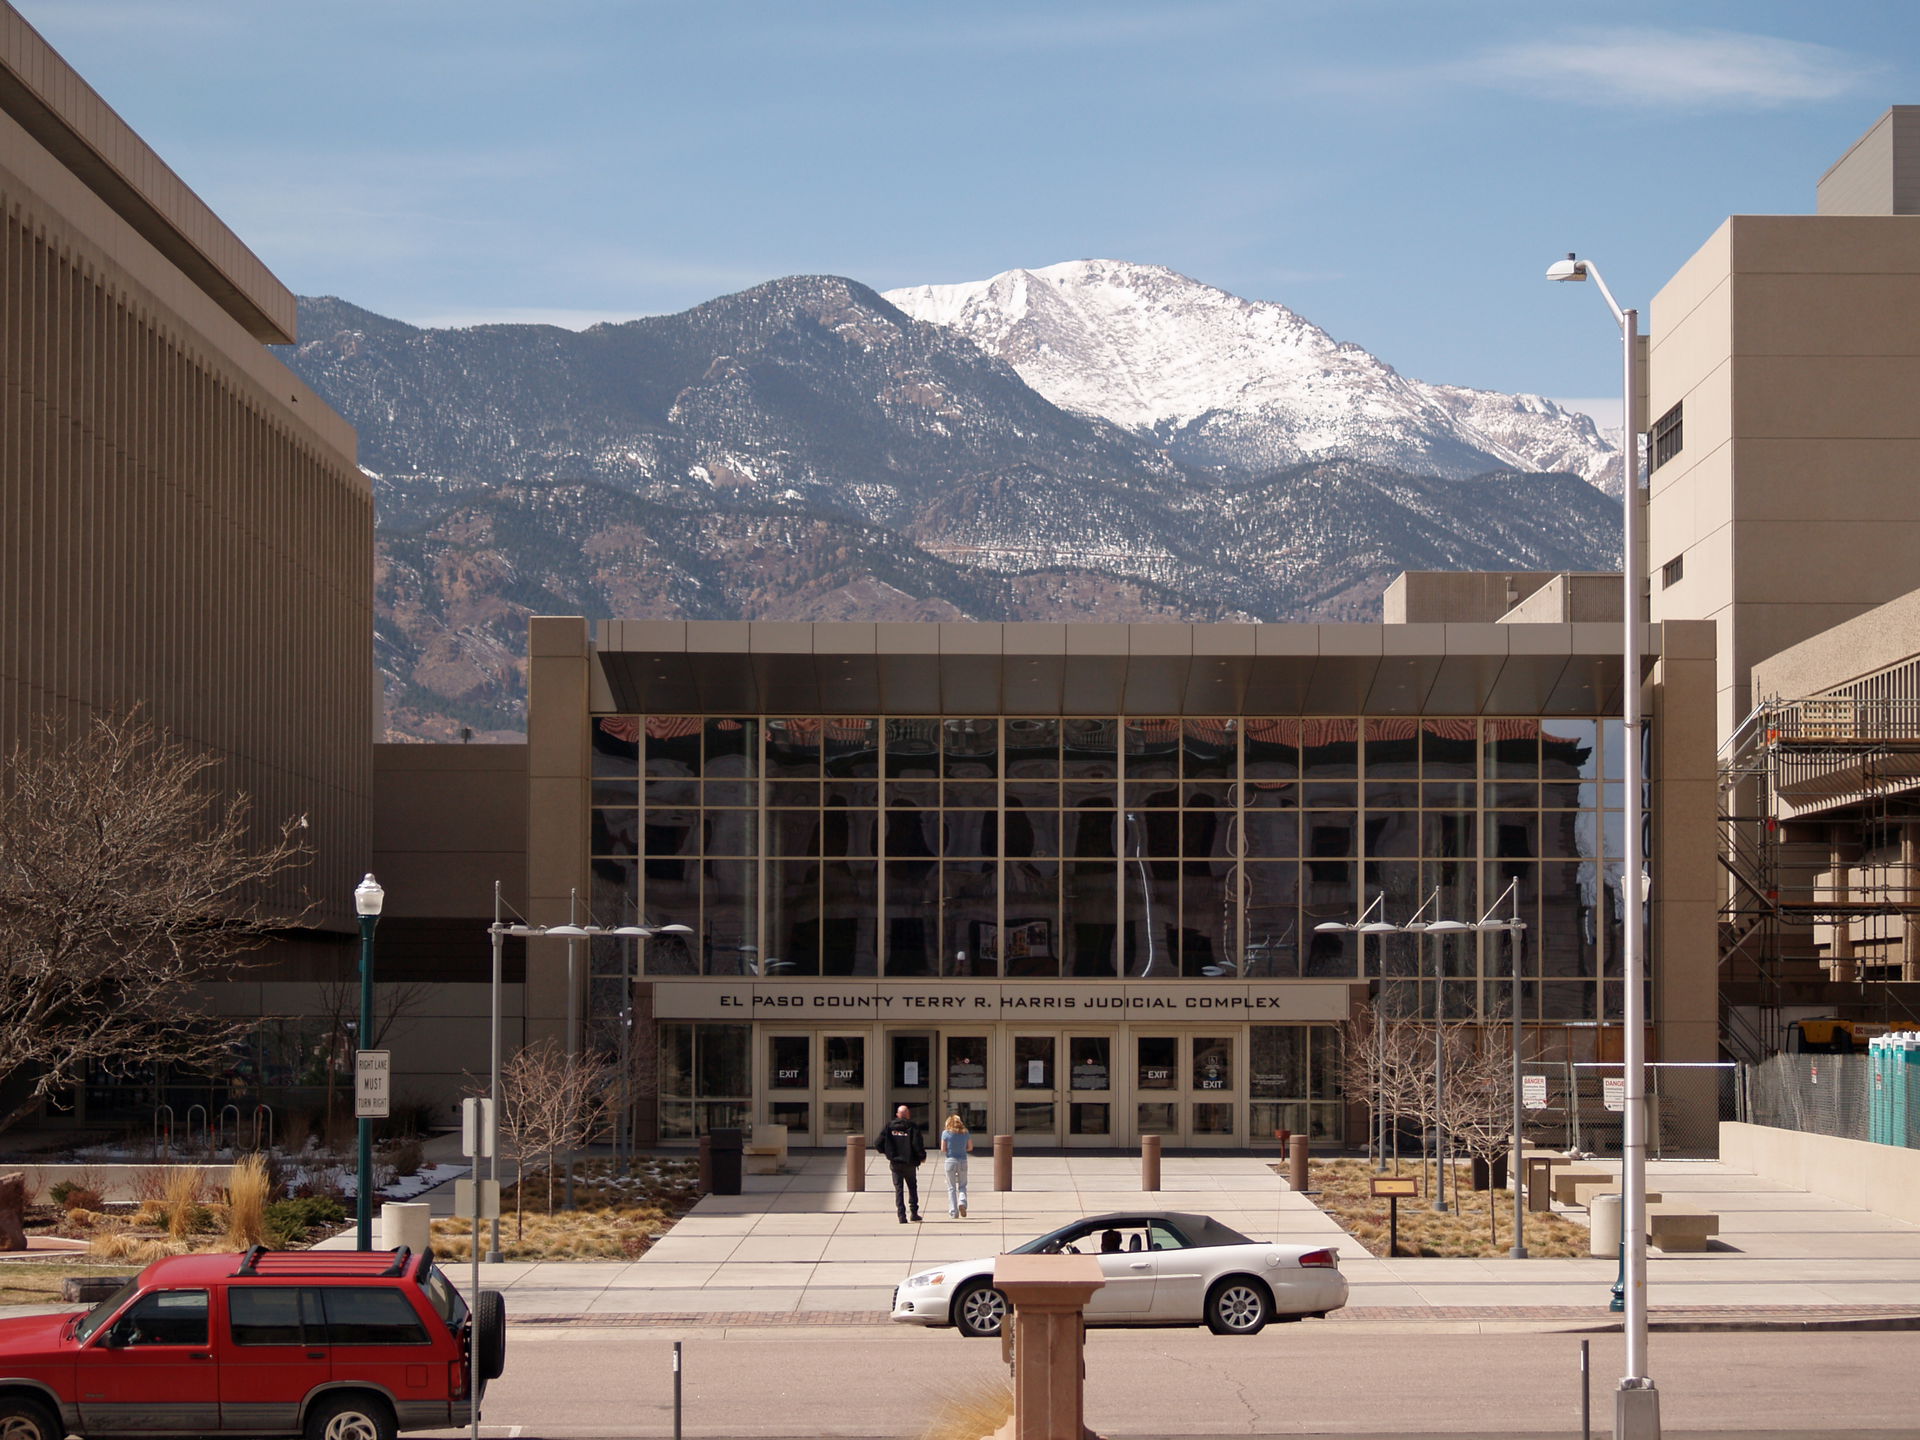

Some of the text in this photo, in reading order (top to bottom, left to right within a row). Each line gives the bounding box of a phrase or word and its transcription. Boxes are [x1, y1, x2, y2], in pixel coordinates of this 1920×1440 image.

[720, 996, 1281, 1008] EL PASO COUNTY TERRY R. HARRIS JUDICIAL COMPLEX
[359, 1060, 387, 1070] RIGHT LANE
[779, 1070, 799, 1078] EXIT
[834, 1070, 854, 1078] EXIT
[1148, 1070, 1169, 1079] EXIT
[364, 1078, 382, 1090] MUST
[1203, 1080, 1223, 1088] EXIT
[358, 1098, 387, 1108] TURN RIGHT
